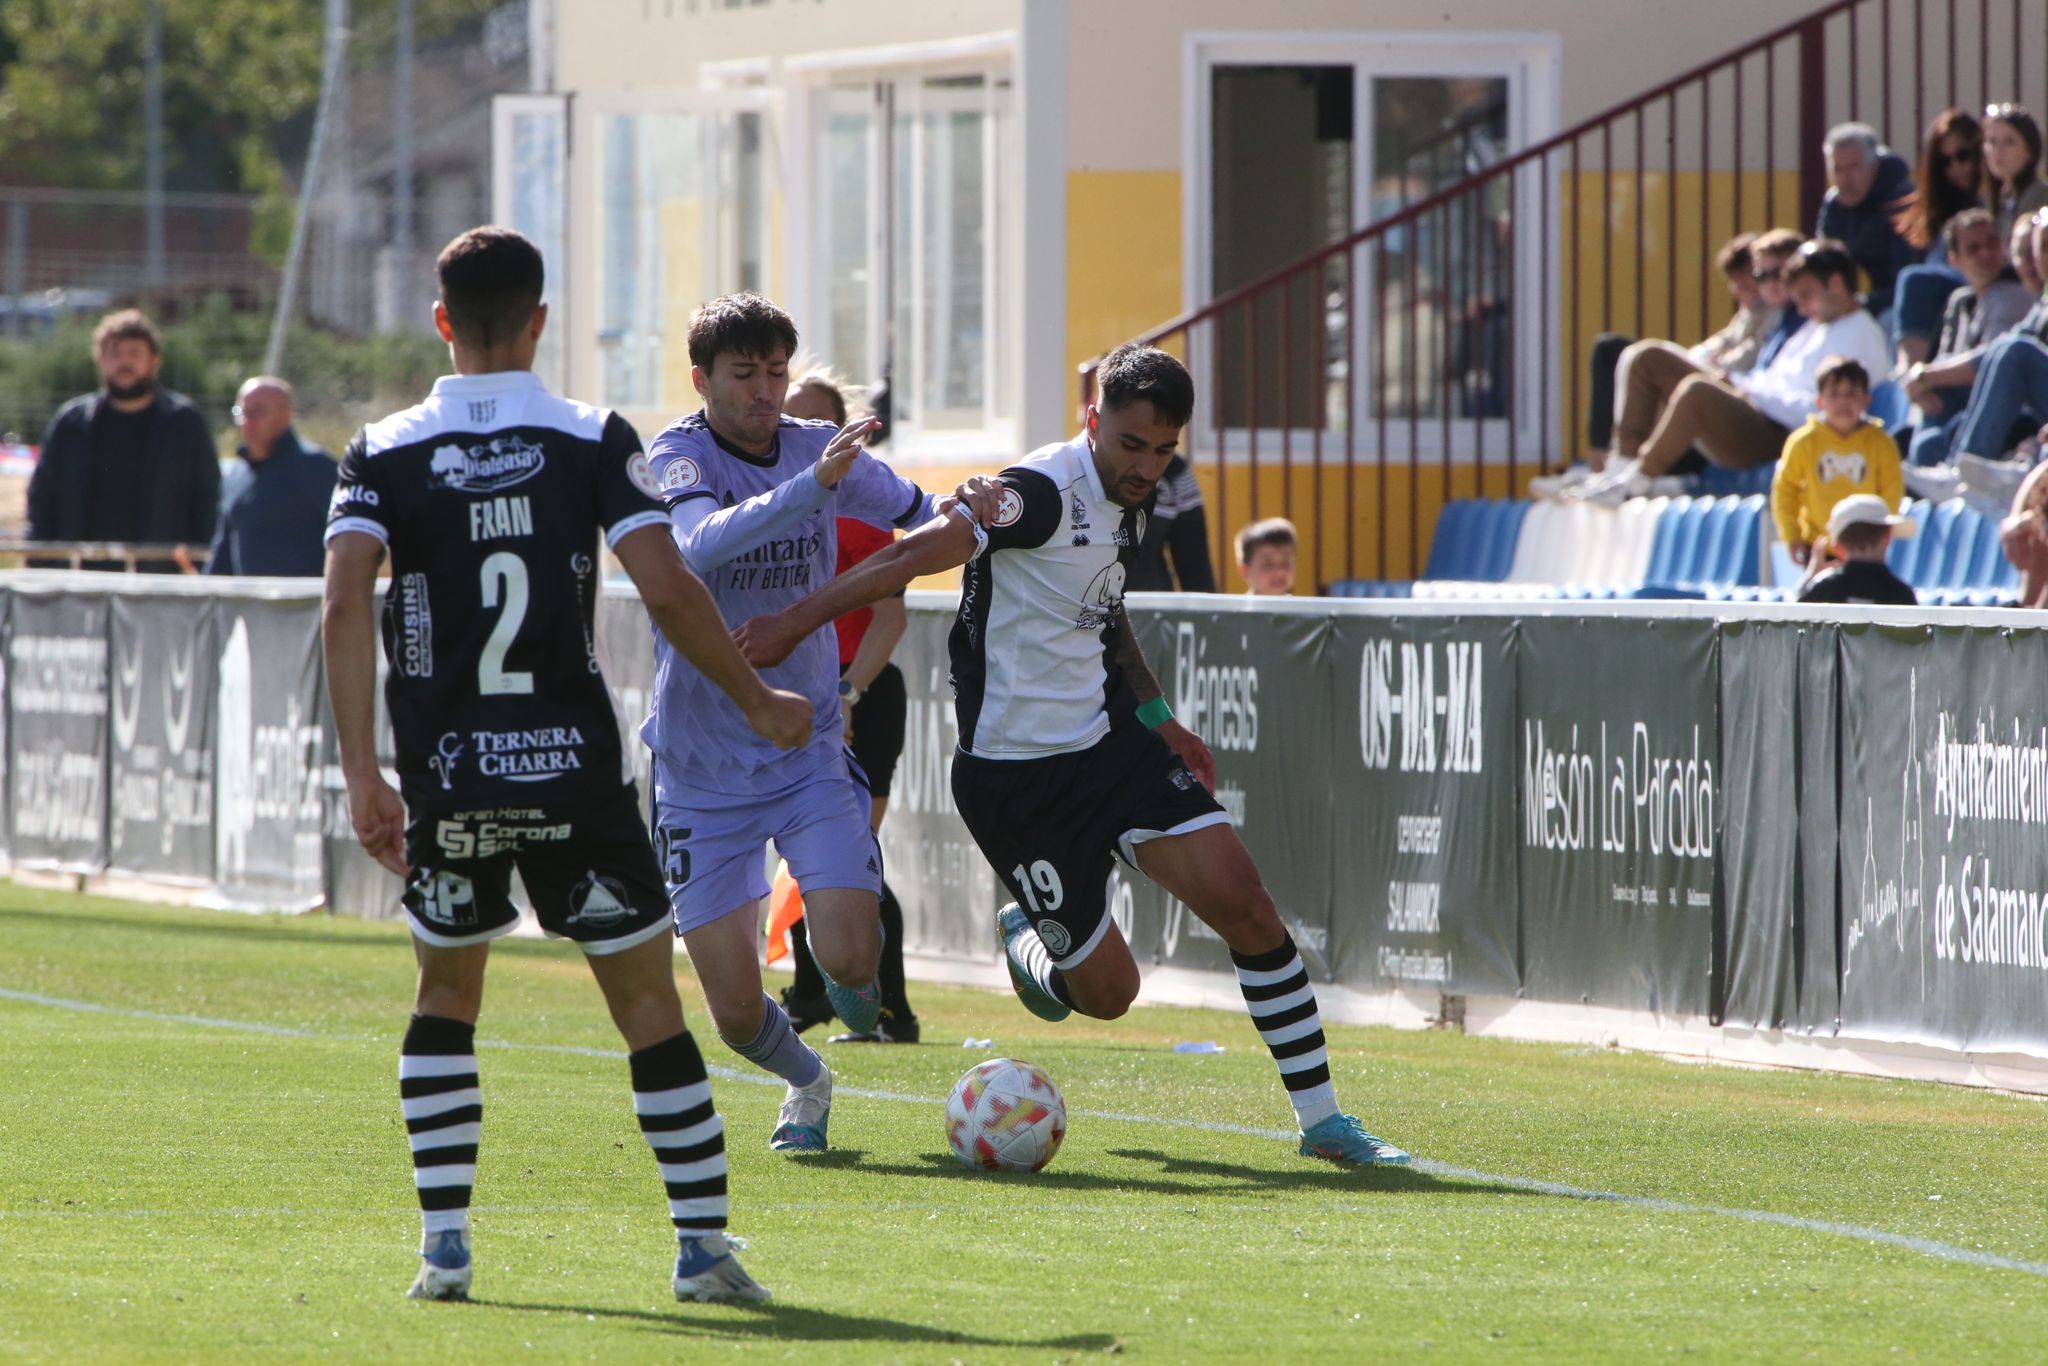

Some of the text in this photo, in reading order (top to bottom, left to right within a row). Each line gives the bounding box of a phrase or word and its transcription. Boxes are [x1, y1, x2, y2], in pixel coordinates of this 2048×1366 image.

[469, 497, 534, 542] FRAN
[730, 567, 758, 591] FLY
[761, 563, 811, 590] BETTER
[402, 573, 420, 676] COUSINS
[478, 551, 534, 696] 2
[1360, 637, 1483, 774] OS-DA-MA
[471, 726, 585, 753] TERNERA
[478, 749, 582, 776] CHARRA
[1525, 718, 1713, 858] Mesón La Parada
[1934, 711, 2048, 842] Ayuntamient
[478, 822, 572, 841] Corona
[1012, 859, 1064, 913] 19
[1934, 855, 1956, 961] de
